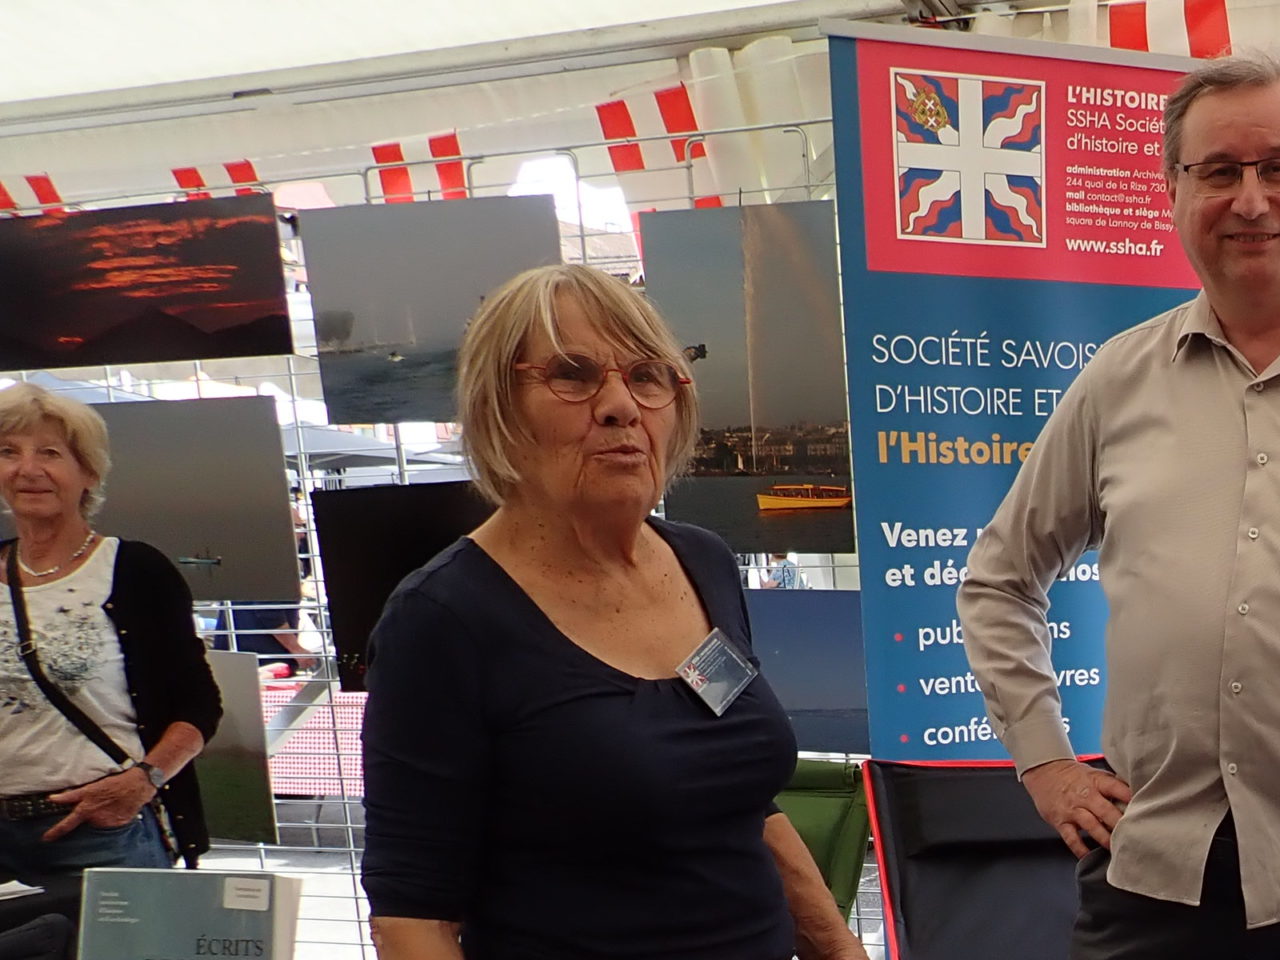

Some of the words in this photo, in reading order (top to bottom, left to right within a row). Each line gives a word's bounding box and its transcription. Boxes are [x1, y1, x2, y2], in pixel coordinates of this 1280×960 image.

[1066, 109, 1111, 130] SSHA
[1115, 113, 1165, 134] Sociét
[1066, 133, 1138, 154] d'histoire
[1143, 140, 1160, 156] et
[1066, 165, 1131, 178] administration
[1066, 190, 1085, 200] mail
[1087, 193, 1151, 205] contact@ssha.fr
[1106, 181, 1117, 189] de
[1120, 181, 1128, 190] la
[1149, 183, 1167, 193] 730
[1066, 202, 1121, 215] bibliothèque
[1095, 217, 1106, 226] de
[1140, 221, 1152, 230] de
[1066, 238, 1164, 256] www.ssha.fr
[871, 330, 991, 368] SOCIÉTÉ
[1001, 340, 1102, 371] SAVOIS
[875, 384, 1023, 416] D'HISTOIRE
[1034, 390, 1061, 416] ET
[877, 431, 1033, 465] l'Histoire
[881, 522, 968, 548] Venez
[885, 564, 914, 587] et
[195, 933, 264, 956] ÉCRITS
